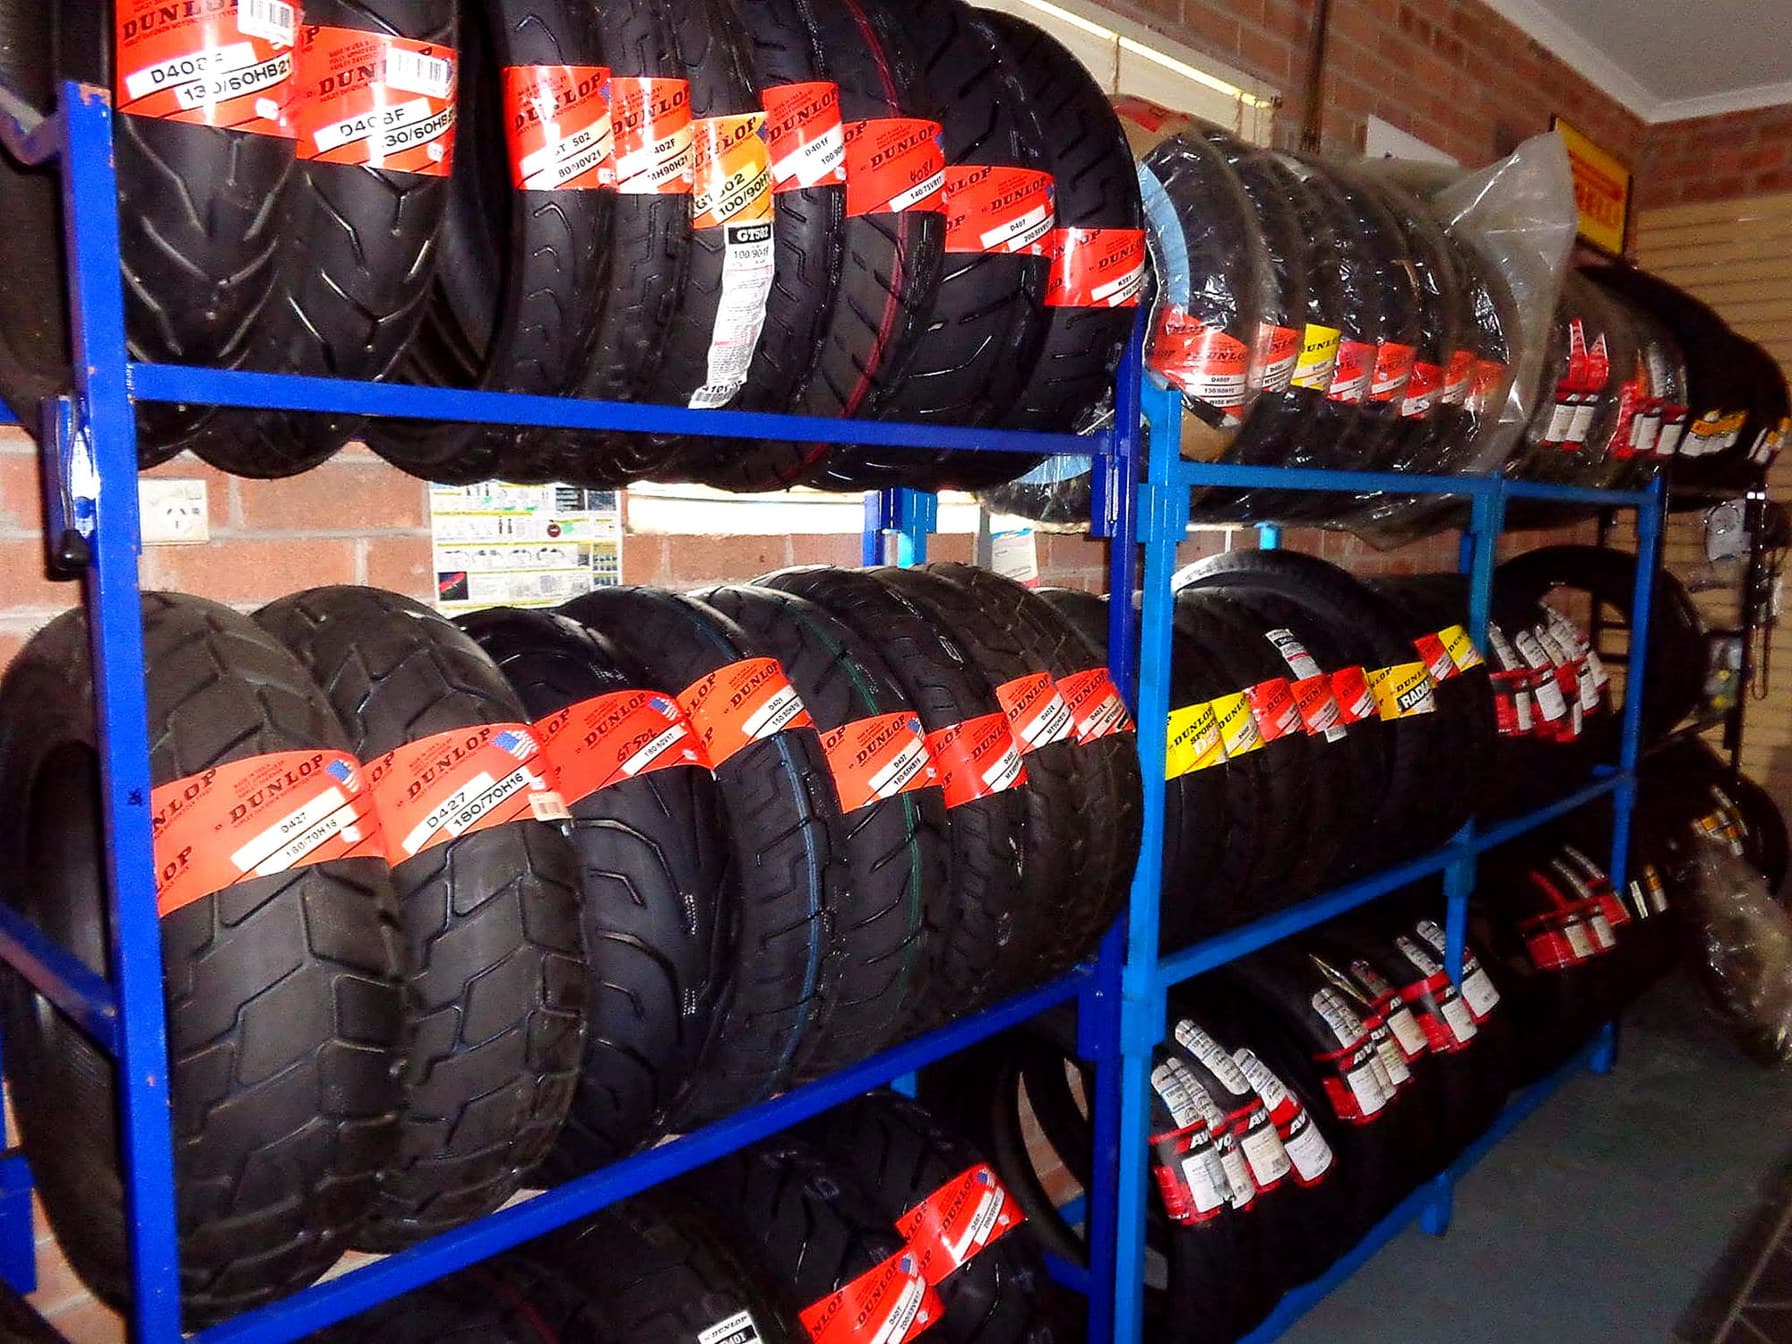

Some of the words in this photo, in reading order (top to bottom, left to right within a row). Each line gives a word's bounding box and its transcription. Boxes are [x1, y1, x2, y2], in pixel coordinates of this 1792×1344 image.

[123, 0, 239, 41] DUNLO
[514, 72, 601, 131] DULOP
[869, 124, 936, 168] DUNLOP
[719, 170, 770, 216] 100/90H
[946, 166, 992, 196] NLOP
[990, 176, 1048, 211] DUNLOP
[685, 672, 716, 718] NLOP
[730, 661, 779, 708] DUNLOP
[1008, 673, 1049, 721] DUNLOP
[1396, 671, 1422, 693] DUNL
[584, 692, 646, 747] DUNLOP
[856, 713, 906, 765] DUNLOP
[971, 719, 1010, 759] DUNLO
[407, 727, 490, 800] DUNLOP
[153, 768, 216, 833] NLOP
[229, 753, 323, 825] DUNLOP
[426, 791, 467, 829] D427
[453, 772, 524, 828] 180/70H16
[280, 811, 307, 834] D427
[942, 1172, 974, 1230] DUNLOP
[812, 1289, 844, 1334] NLOP
[857, 1260, 897, 1325] DUNLOP
[711, 1315, 748, 1338] DUNLOP
